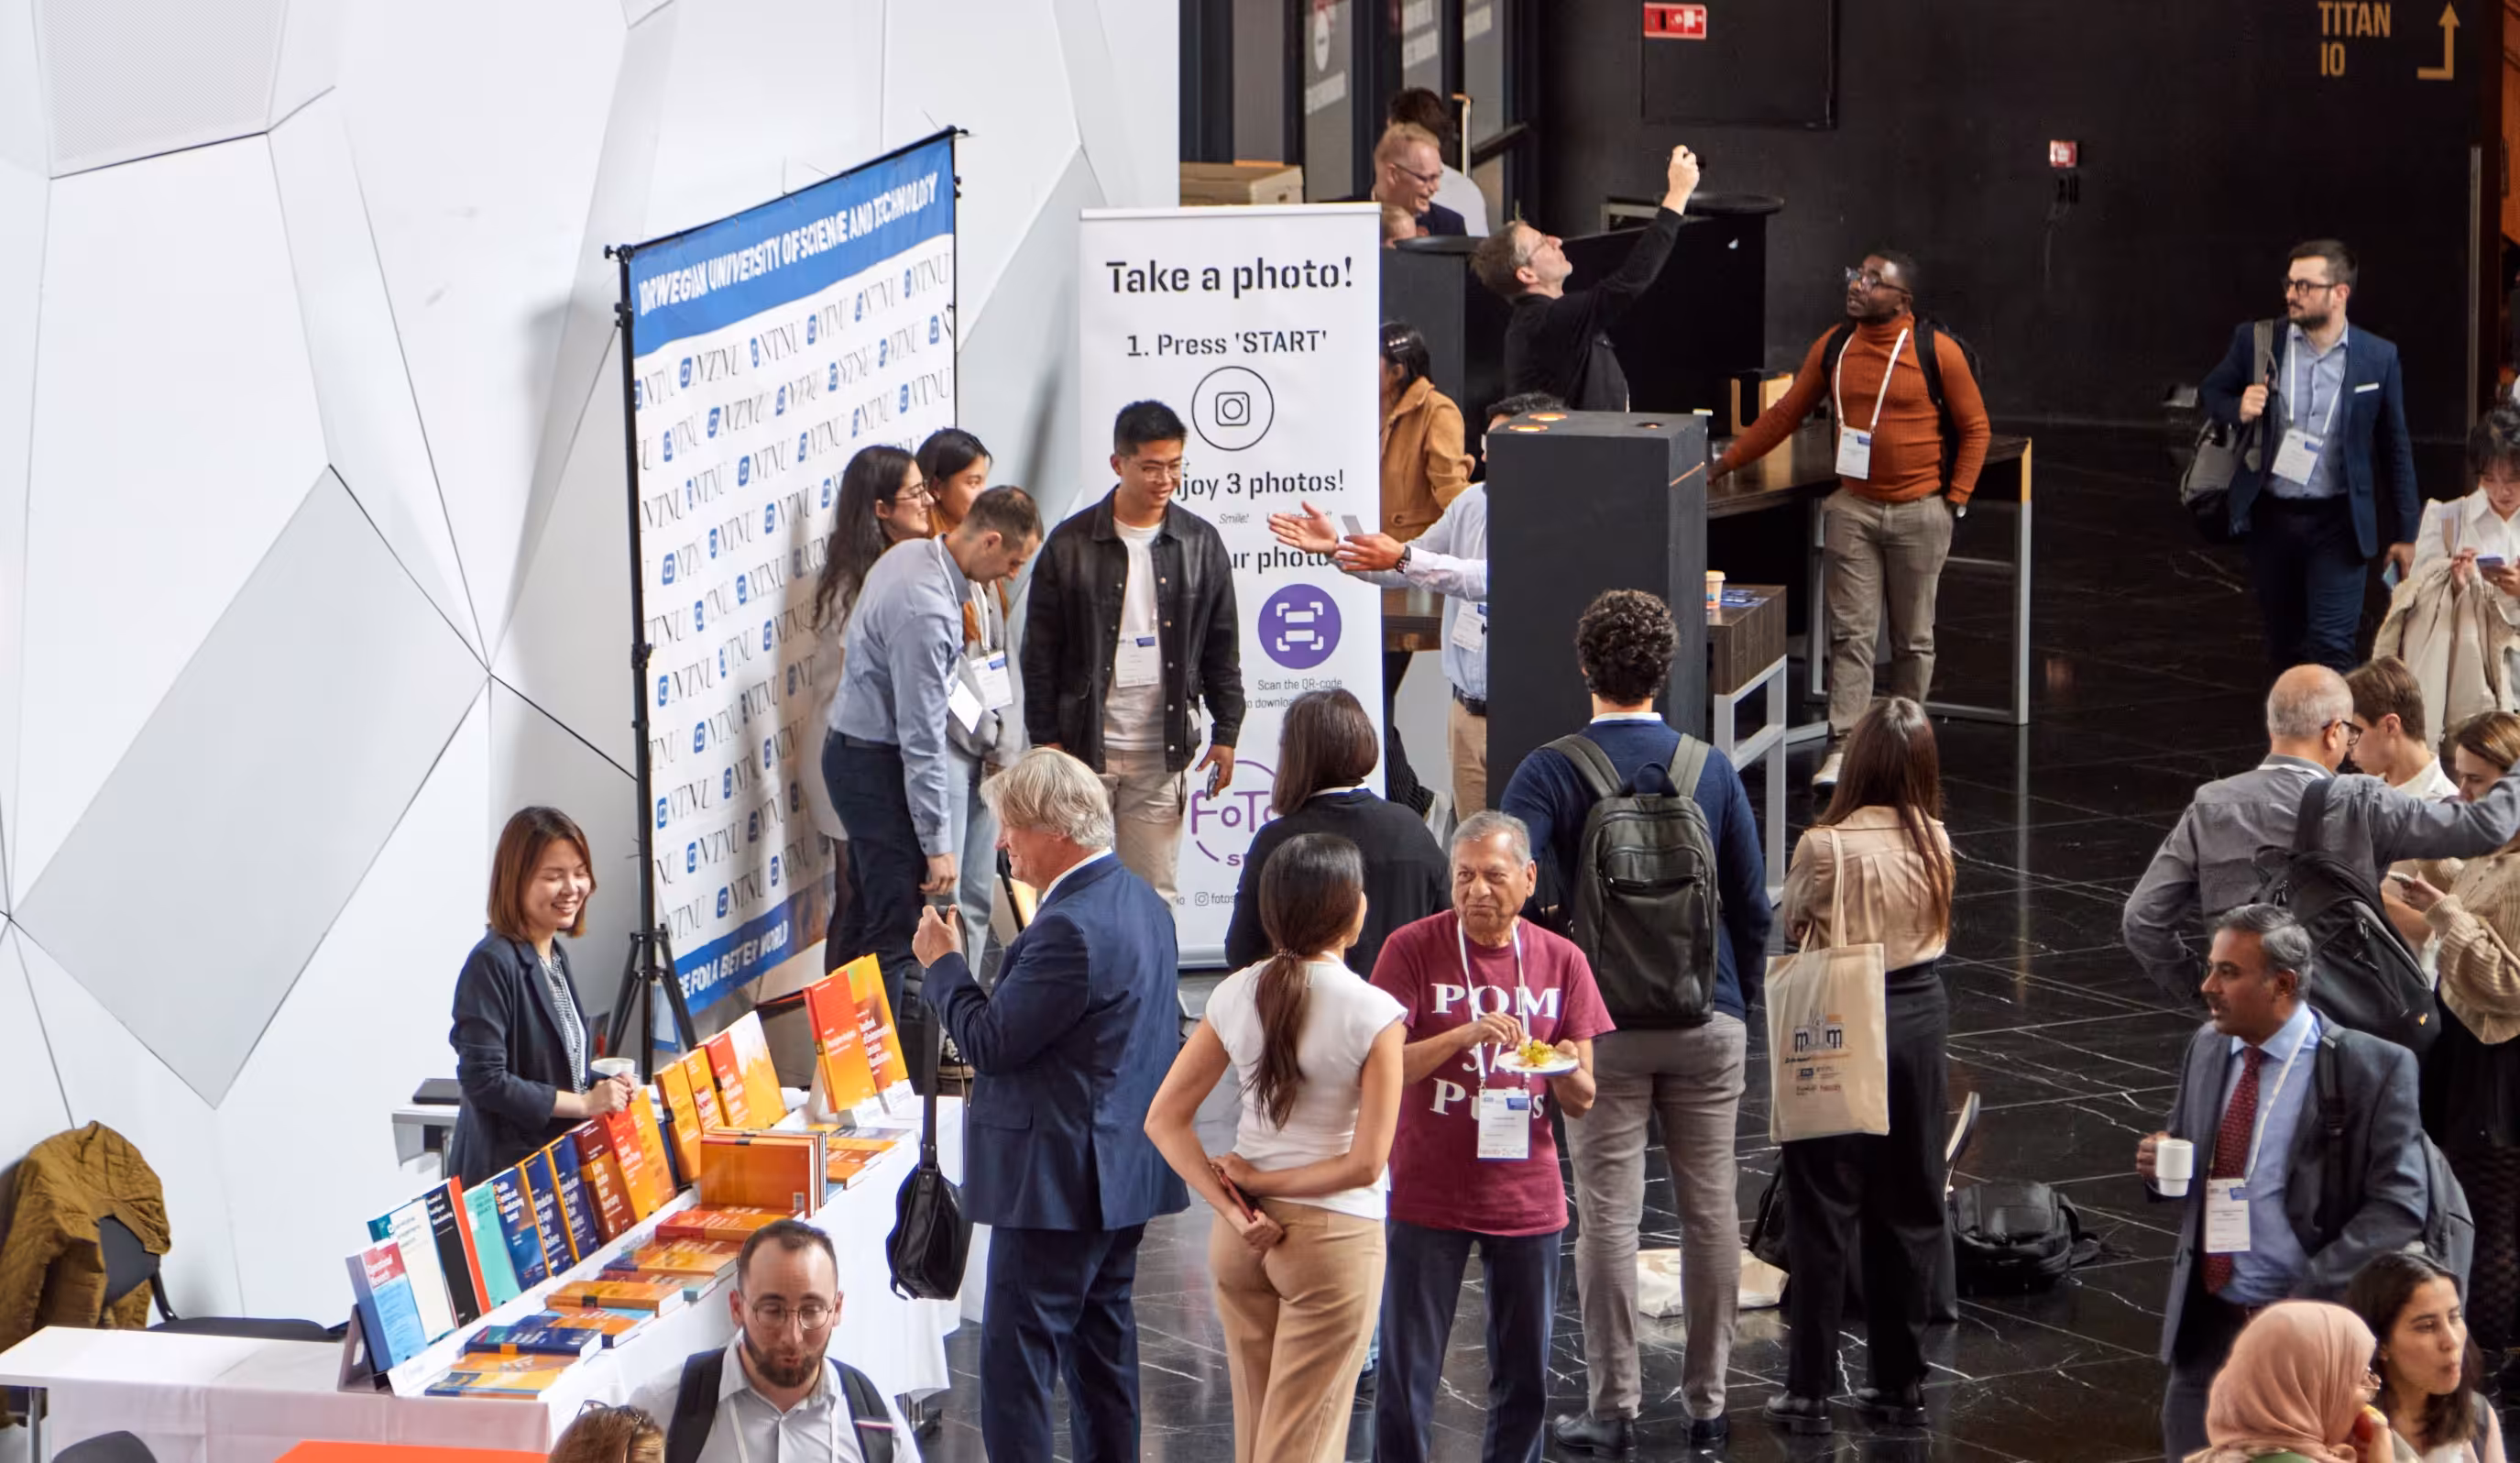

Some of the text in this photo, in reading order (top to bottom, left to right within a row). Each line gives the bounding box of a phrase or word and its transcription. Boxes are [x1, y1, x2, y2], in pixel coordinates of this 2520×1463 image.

[2317, 1, 2391, 37] TITAN
[782, 228, 800, 265] OF
[800, 210, 848, 258] SCIENE
[849, 201, 873, 240] AND
[1106, 256, 1353, 299] Take a photo!
[1127, 330, 1327, 357] 1. Press 'START'
[1177, 469, 1344, 500] joy 3 photos!
[644, 608, 687, 649] TNU
[1257, 677, 1342, 691] Scan the QR-code
[1255, 697, 1293, 710] downlo
[720, 939, 759, 979] BETE
[1430, 983, 1561, 1018] POM
